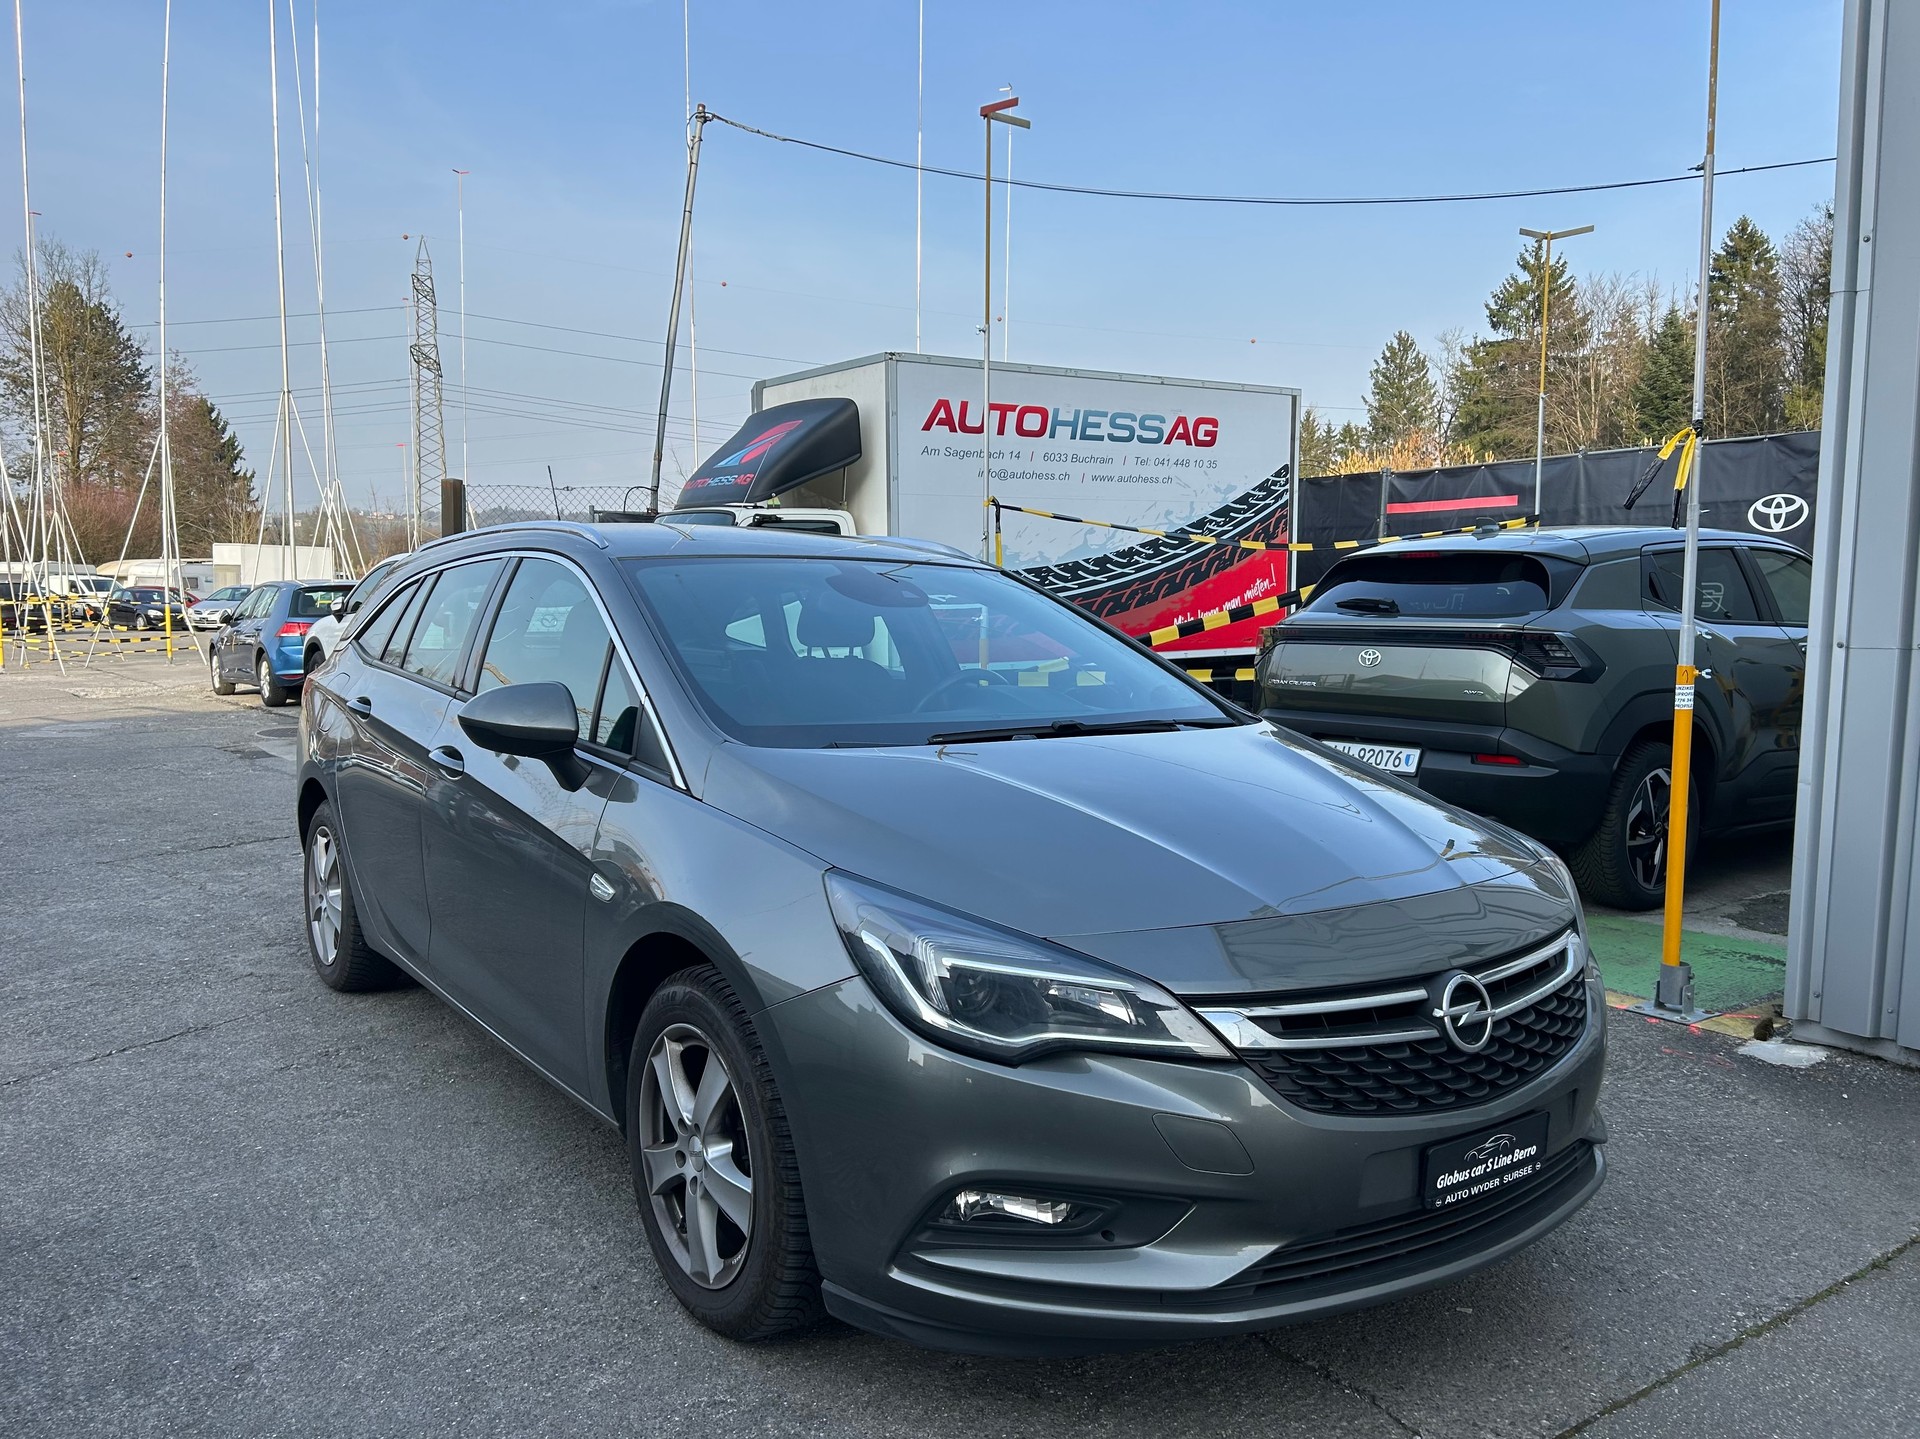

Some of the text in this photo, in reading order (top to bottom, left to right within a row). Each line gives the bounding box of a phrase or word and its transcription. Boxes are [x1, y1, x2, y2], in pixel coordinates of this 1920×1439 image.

[920, 398, 1219, 448] AUTOHESSAG
[921, 445, 940, 457] Am
[944, 446, 1005, 460] Sagenbach
[1008, 450, 1021, 461] 14
[1043, 452, 1069, 463] 6033
[1070, 453, 1114, 465] Buchrain
[1153, 457, 1171, 468] 041
[1173, 458, 1191, 469] 448
[1193, 459, 1205, 469] 10
[1206, 460, 1218, 469] 35
[1091, 473, 1173, 485] www.autohess.ch
[1222, 595, 1242, 611] man
[1436, 1145, 1537, 1189] Globus car S Line Berro
[1444, 1165, 1533, 1205] AUTO WYDER SURSEE
